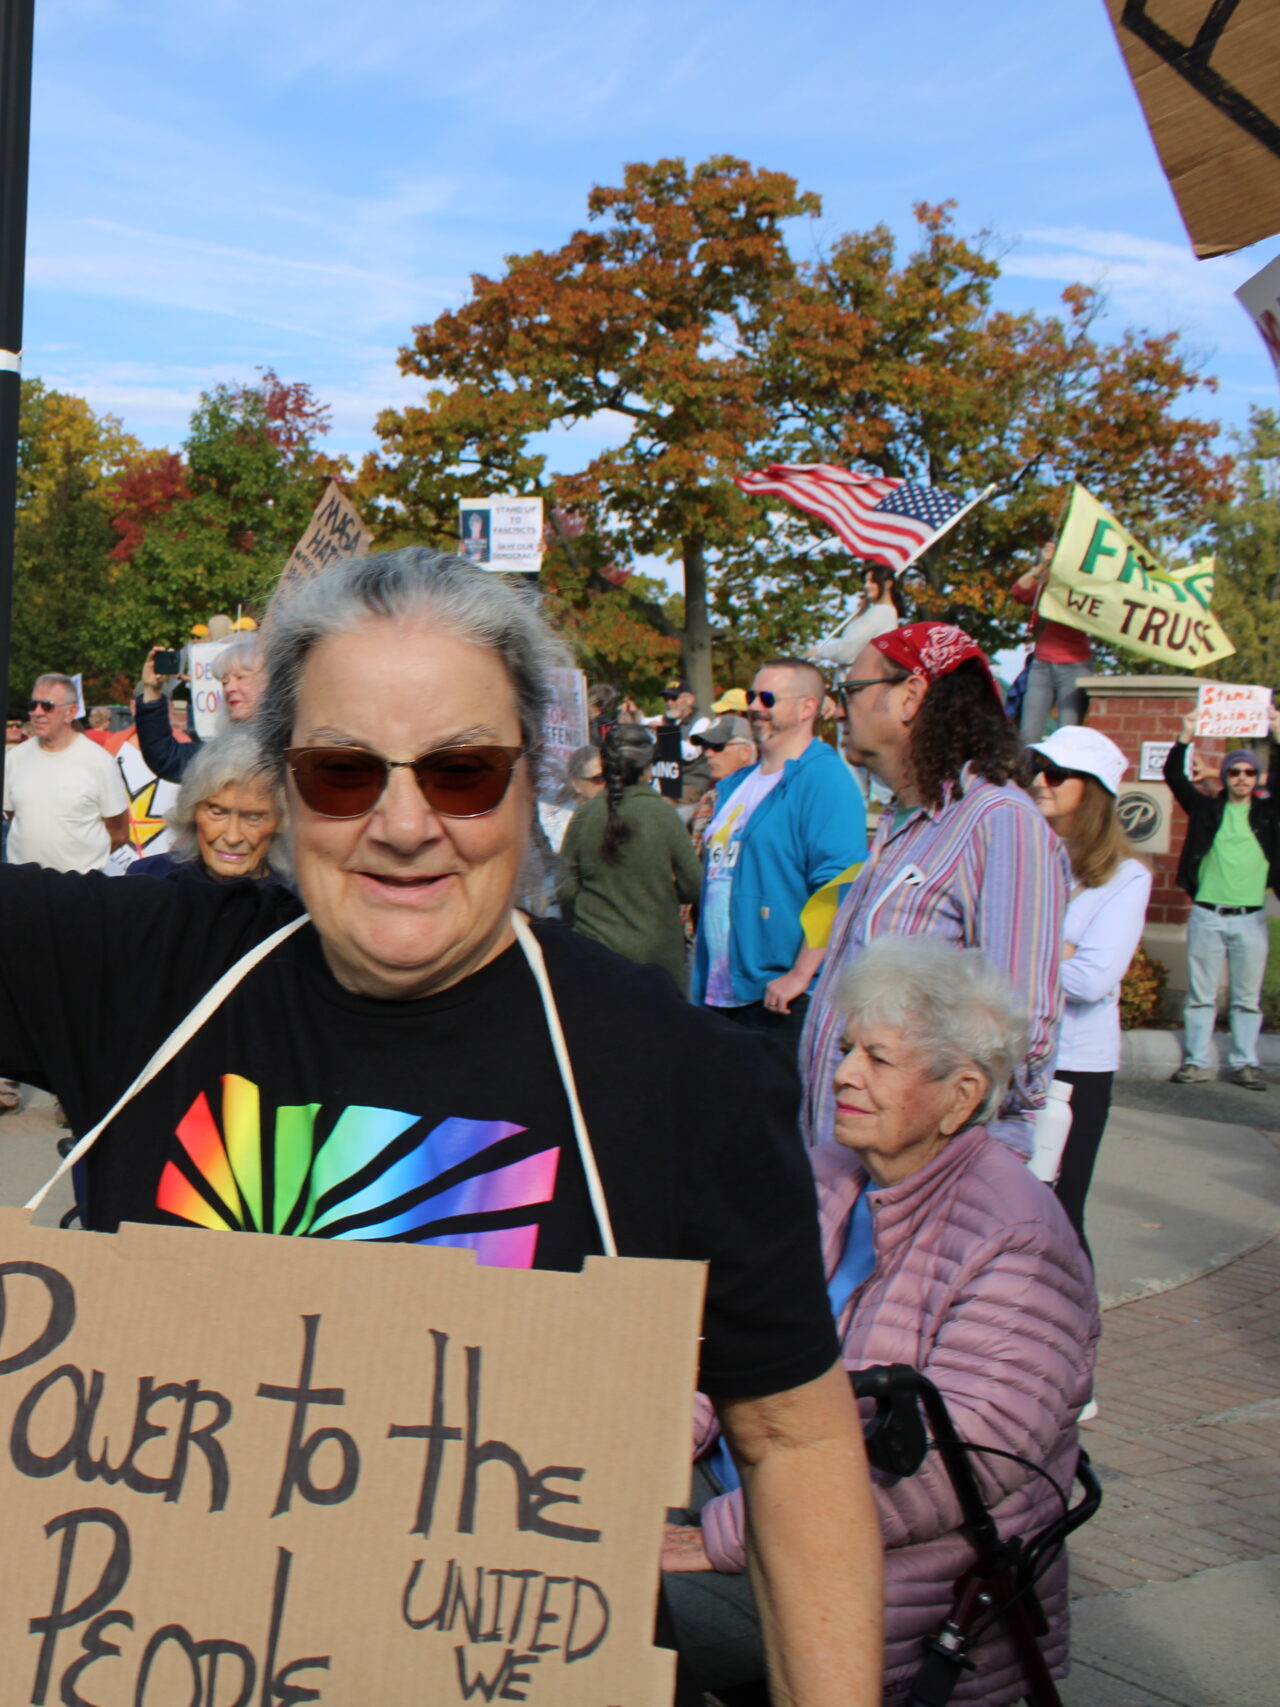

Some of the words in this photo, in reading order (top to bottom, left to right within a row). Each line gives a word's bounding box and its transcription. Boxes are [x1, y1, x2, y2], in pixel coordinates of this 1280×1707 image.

[317, 496, 361, 556] MAGA
[1067, 588, 1104, 618] WE
[257, 1313, 360, 1518] to
[402, 1559, 610, 1664] UNITED
[453, 1645, 540, 1703] WE
